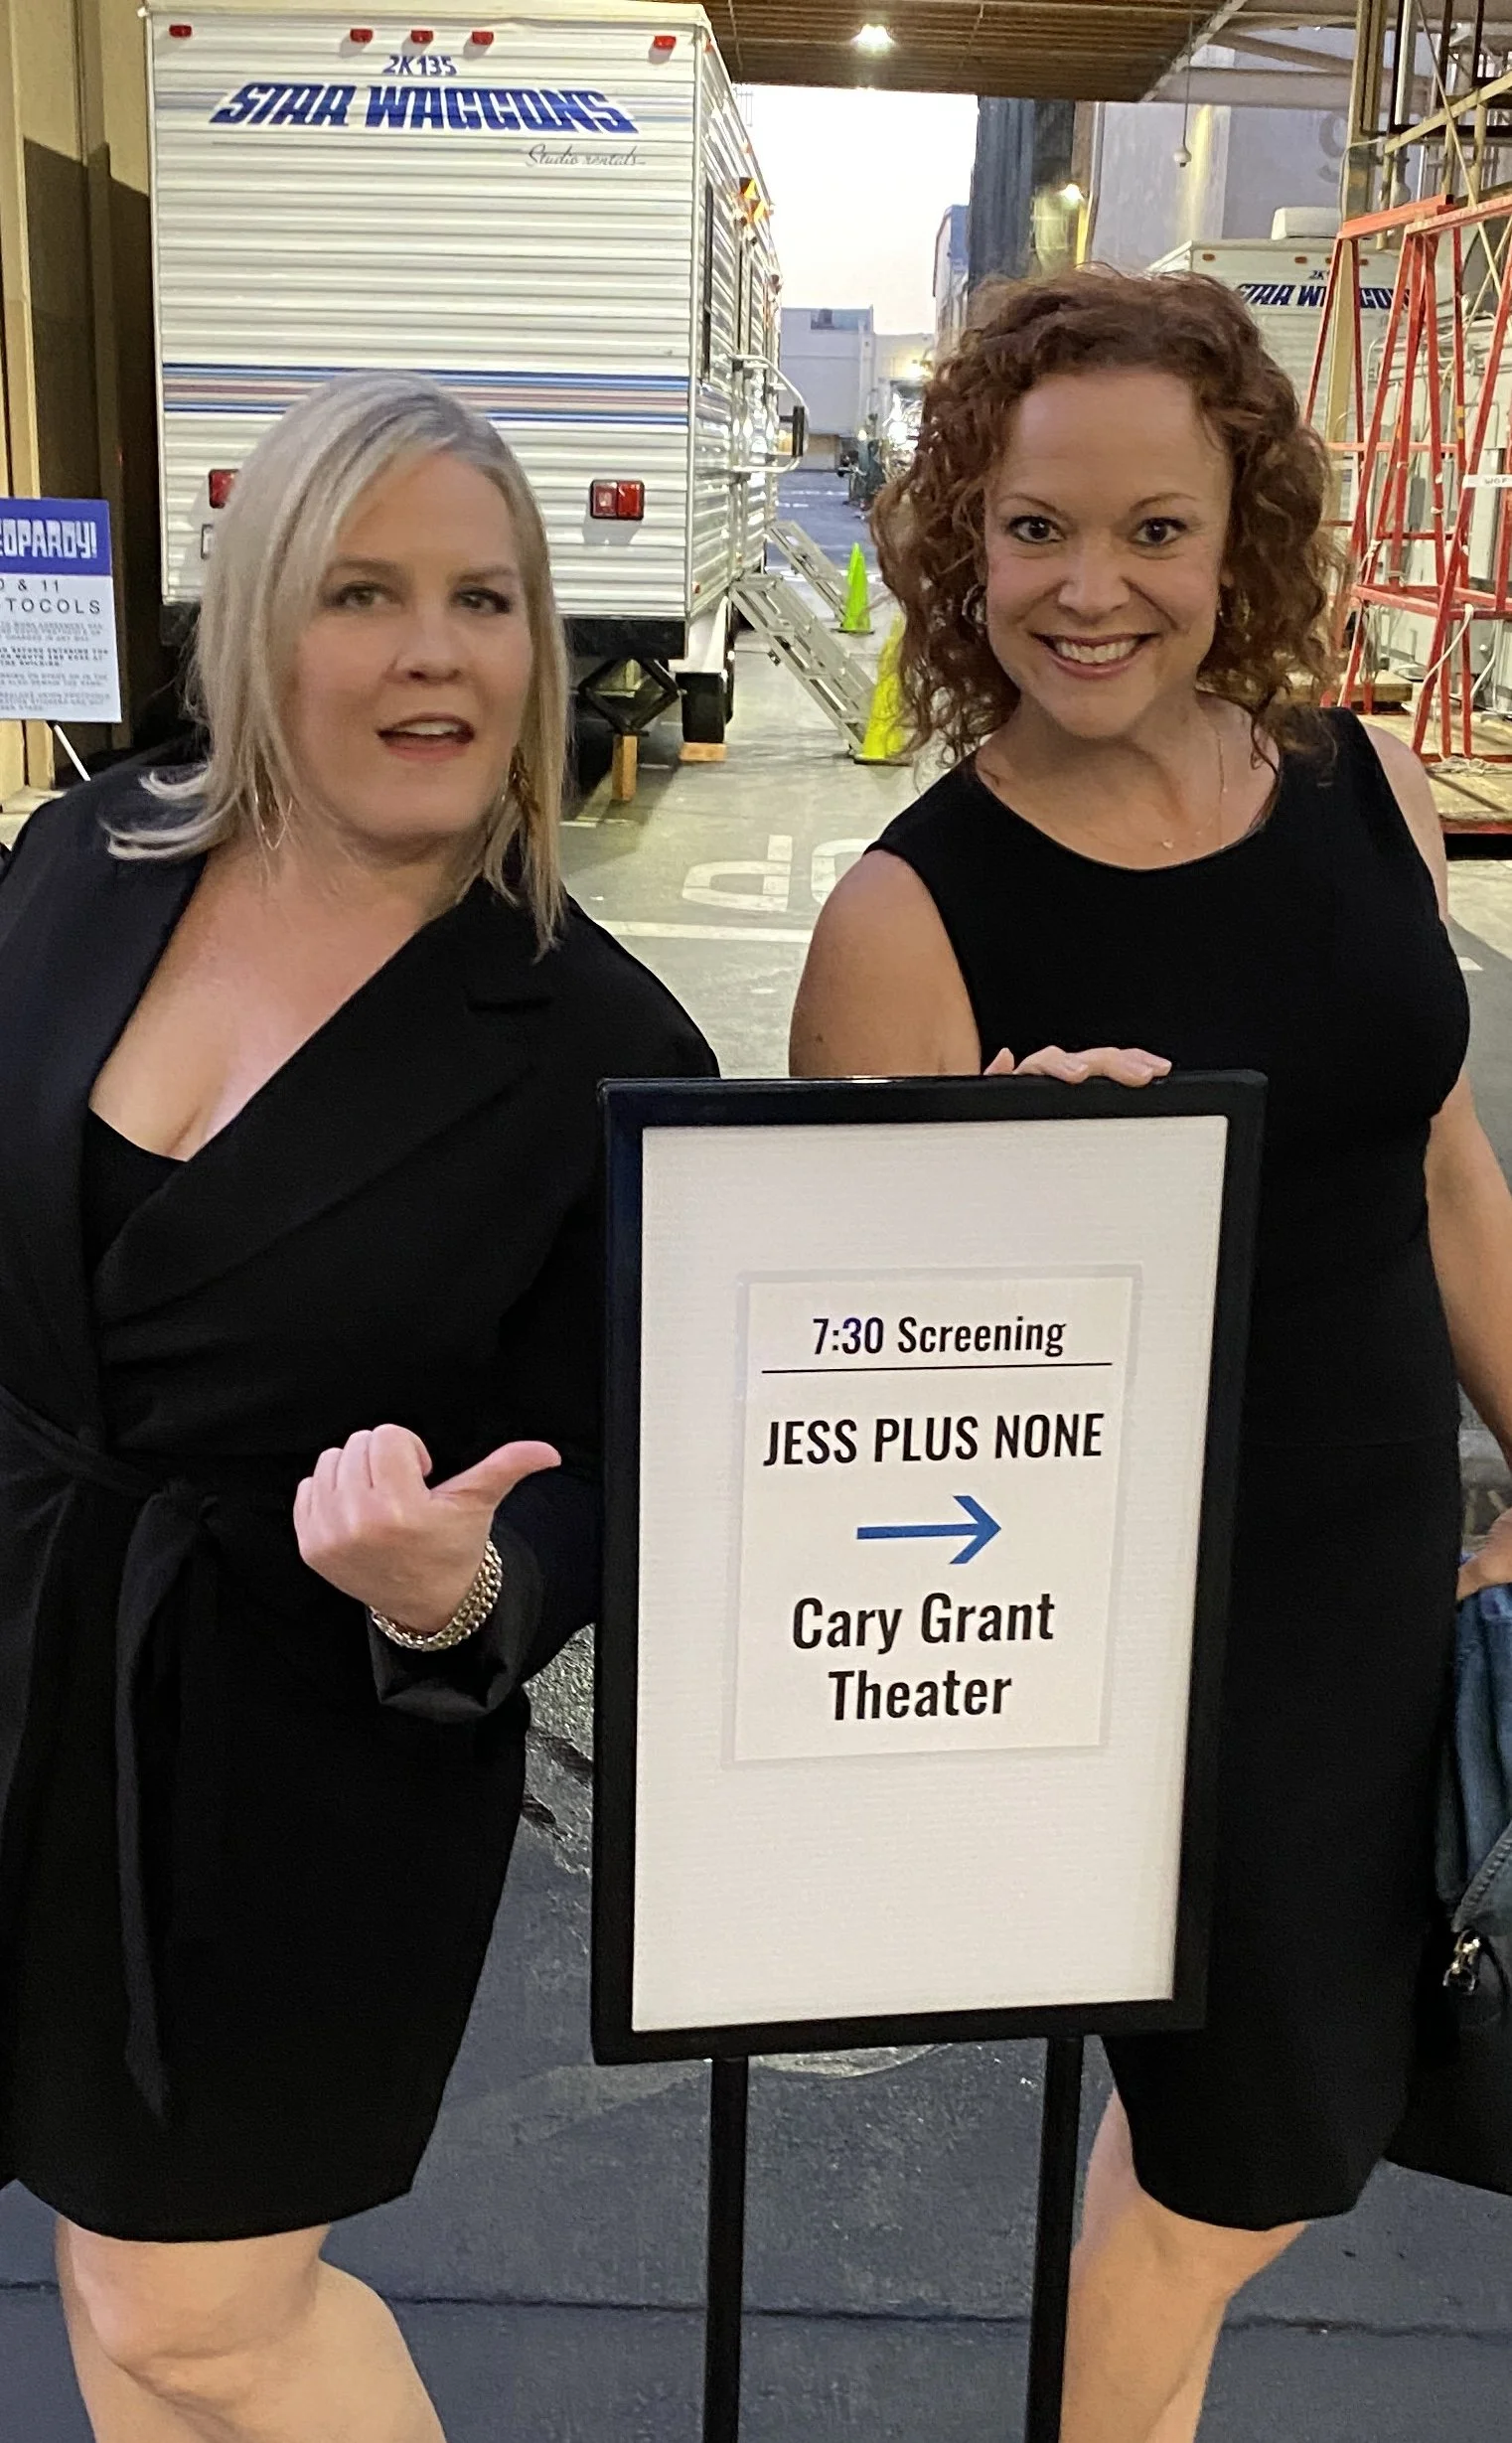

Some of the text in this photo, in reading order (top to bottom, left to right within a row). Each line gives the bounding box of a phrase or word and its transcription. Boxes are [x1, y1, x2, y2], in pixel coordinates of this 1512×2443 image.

[209, 82, 639, 133] STAR WAGGONS
[526, 143, 578, 167] Studio
[0, 519, 97, 558] OPARDY!
[813, 1315, 1067, 1358] 7:30 Screening
[763, 1413, 1105, 1466] JESS PLUS NONE
[793, 1592, 1055, 1655] Cary Grant
[828, 1669, 1012, 1721] Theater
